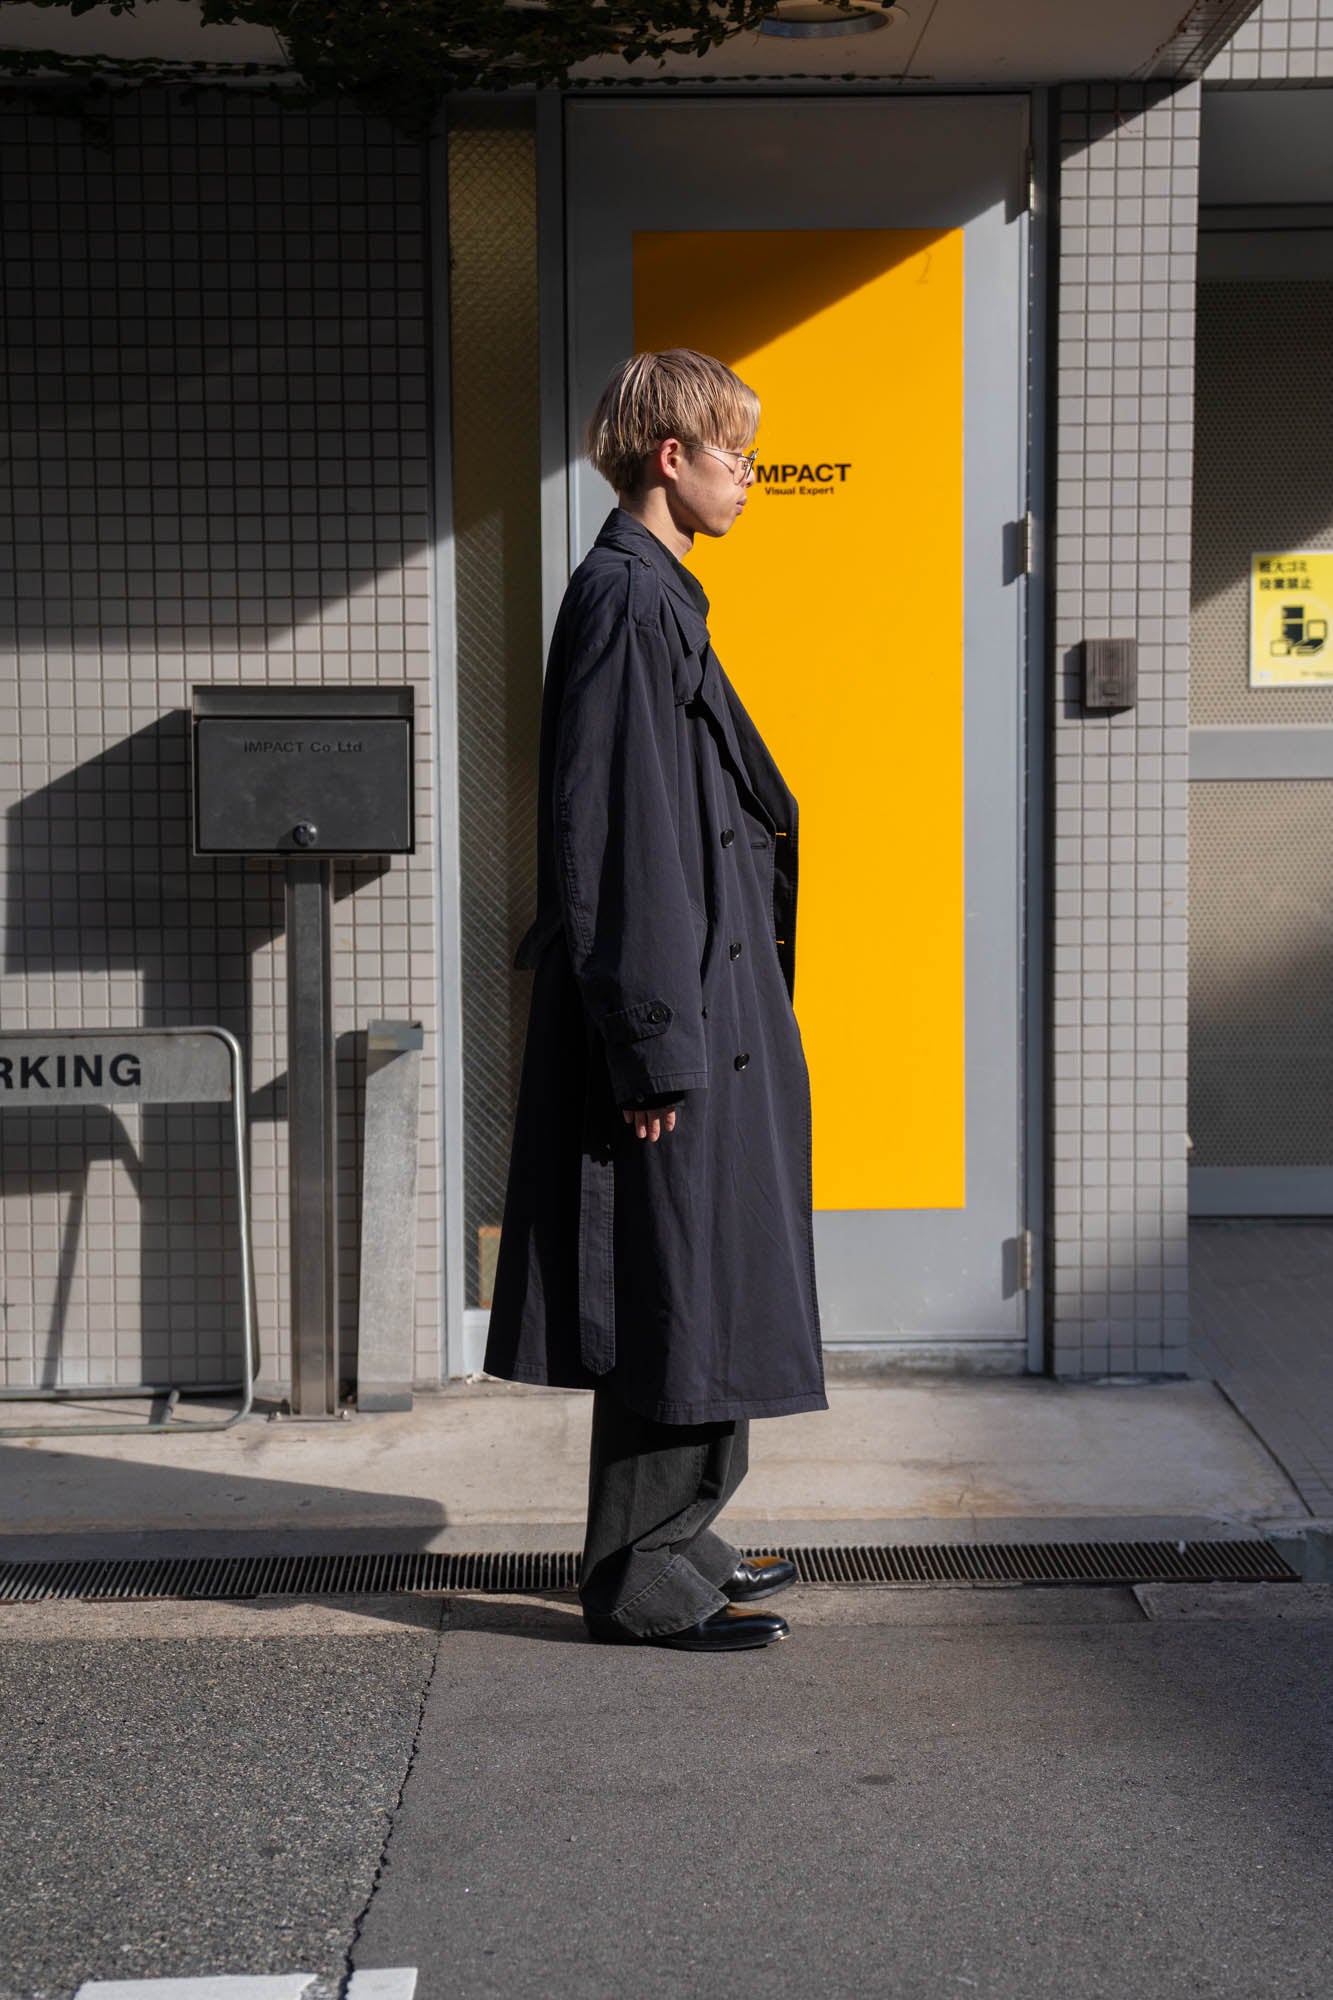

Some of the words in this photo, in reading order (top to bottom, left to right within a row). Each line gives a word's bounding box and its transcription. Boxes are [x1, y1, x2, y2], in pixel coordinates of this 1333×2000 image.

[756, 464, 852, 482] MPACT
[764, 486, 796, 495] Visual
[799, 486, 834, 496] Expert
[244, 741, 304, 753] IMPACT
